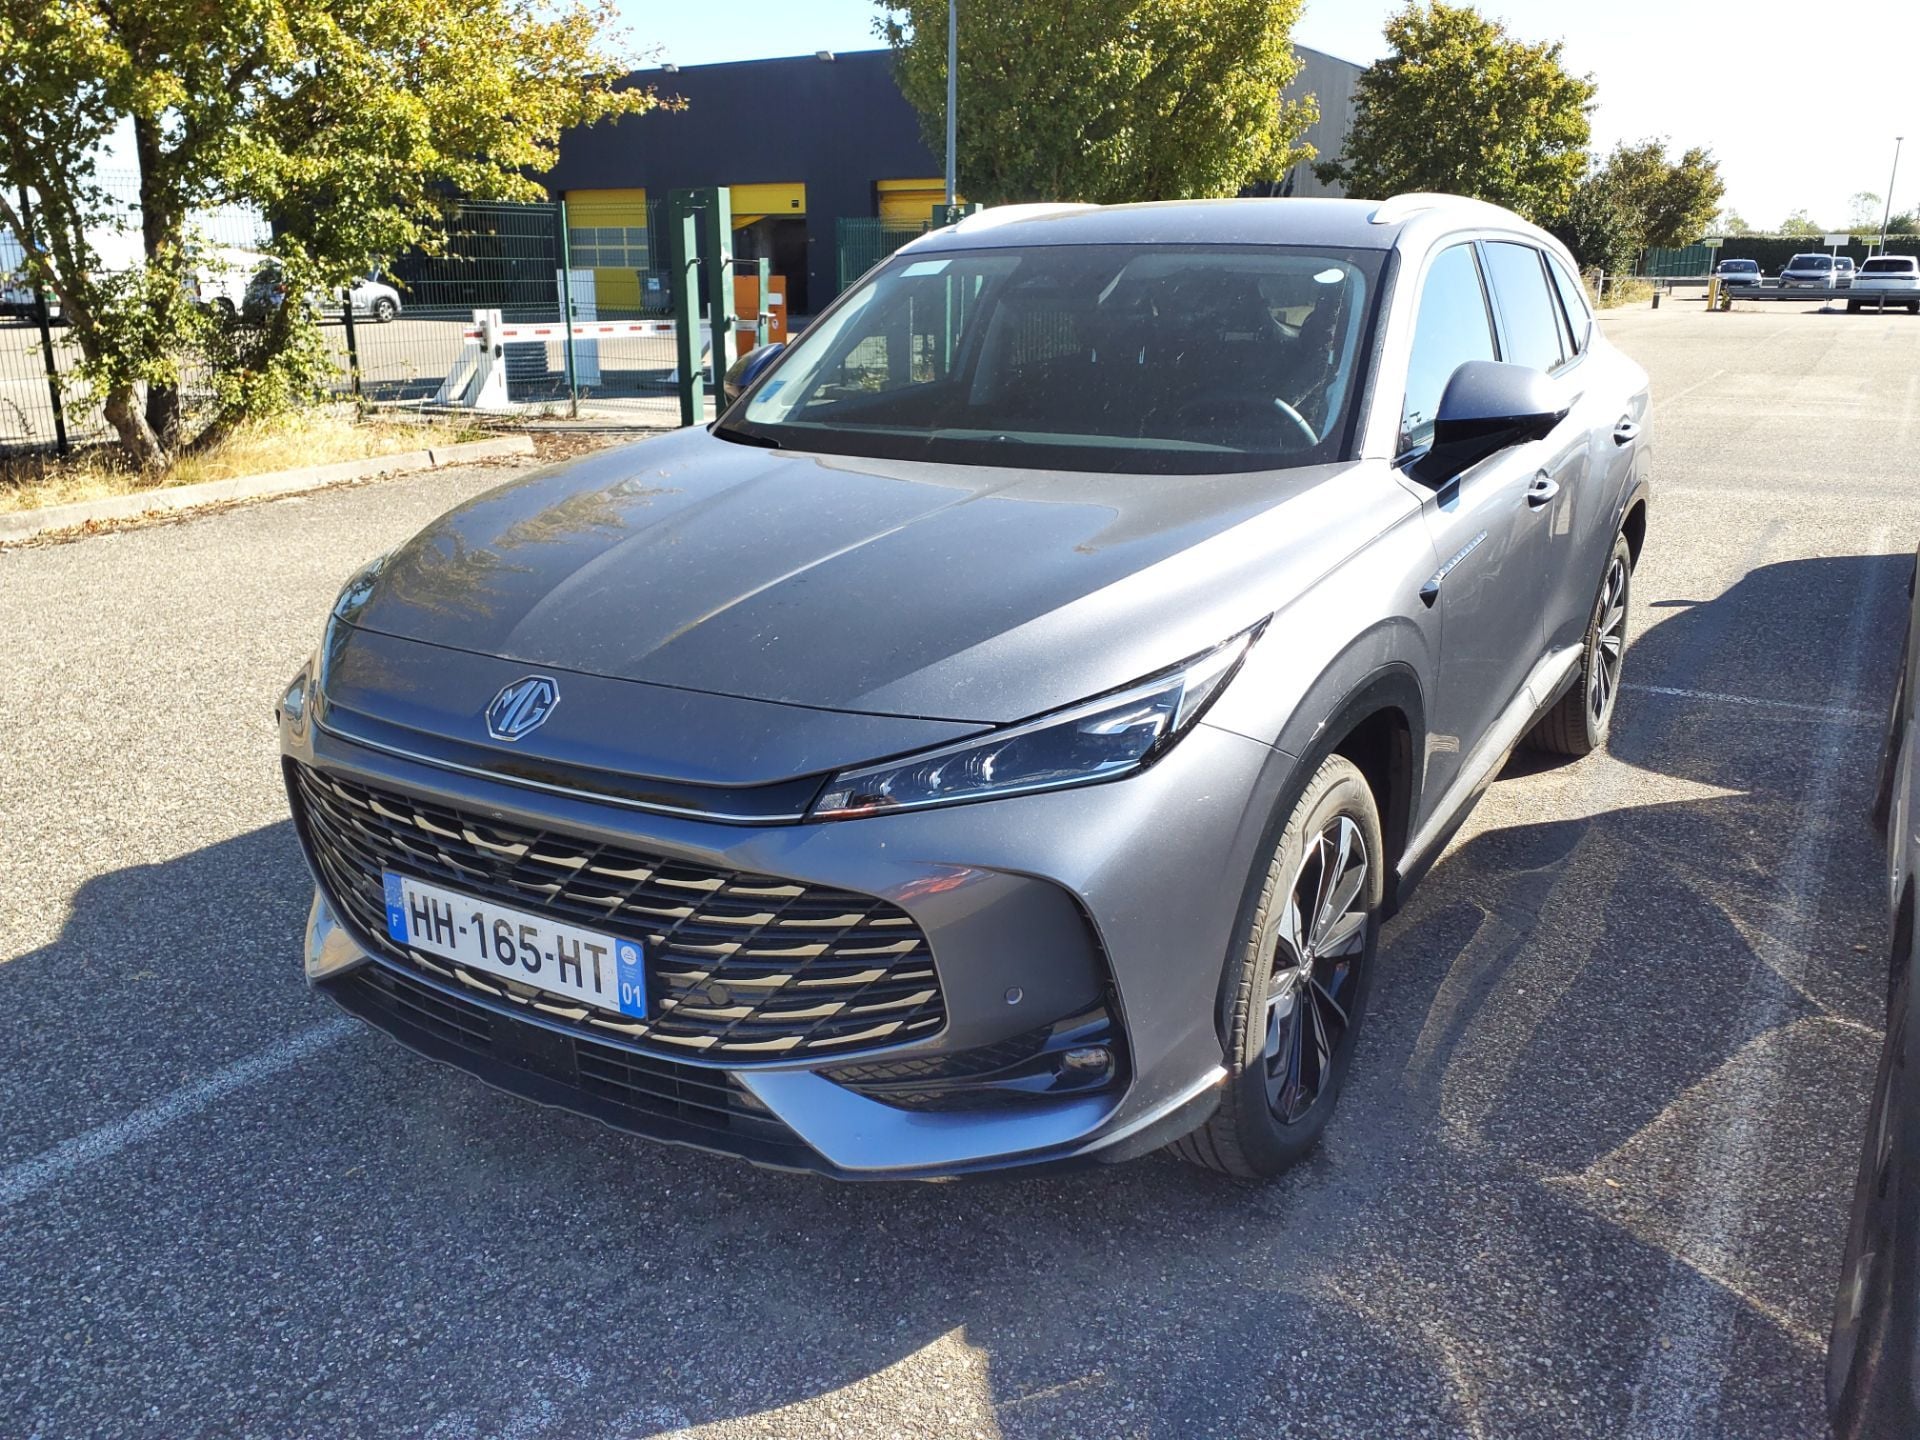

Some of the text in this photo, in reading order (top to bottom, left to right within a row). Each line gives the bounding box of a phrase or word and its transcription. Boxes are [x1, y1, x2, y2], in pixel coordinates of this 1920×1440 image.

[492, 679, 552, 734] MG
[392, 912, 399, 927] F
[408, 890, 607, 994] HH-165-HT
[622, 982, 641, 1008] 01
